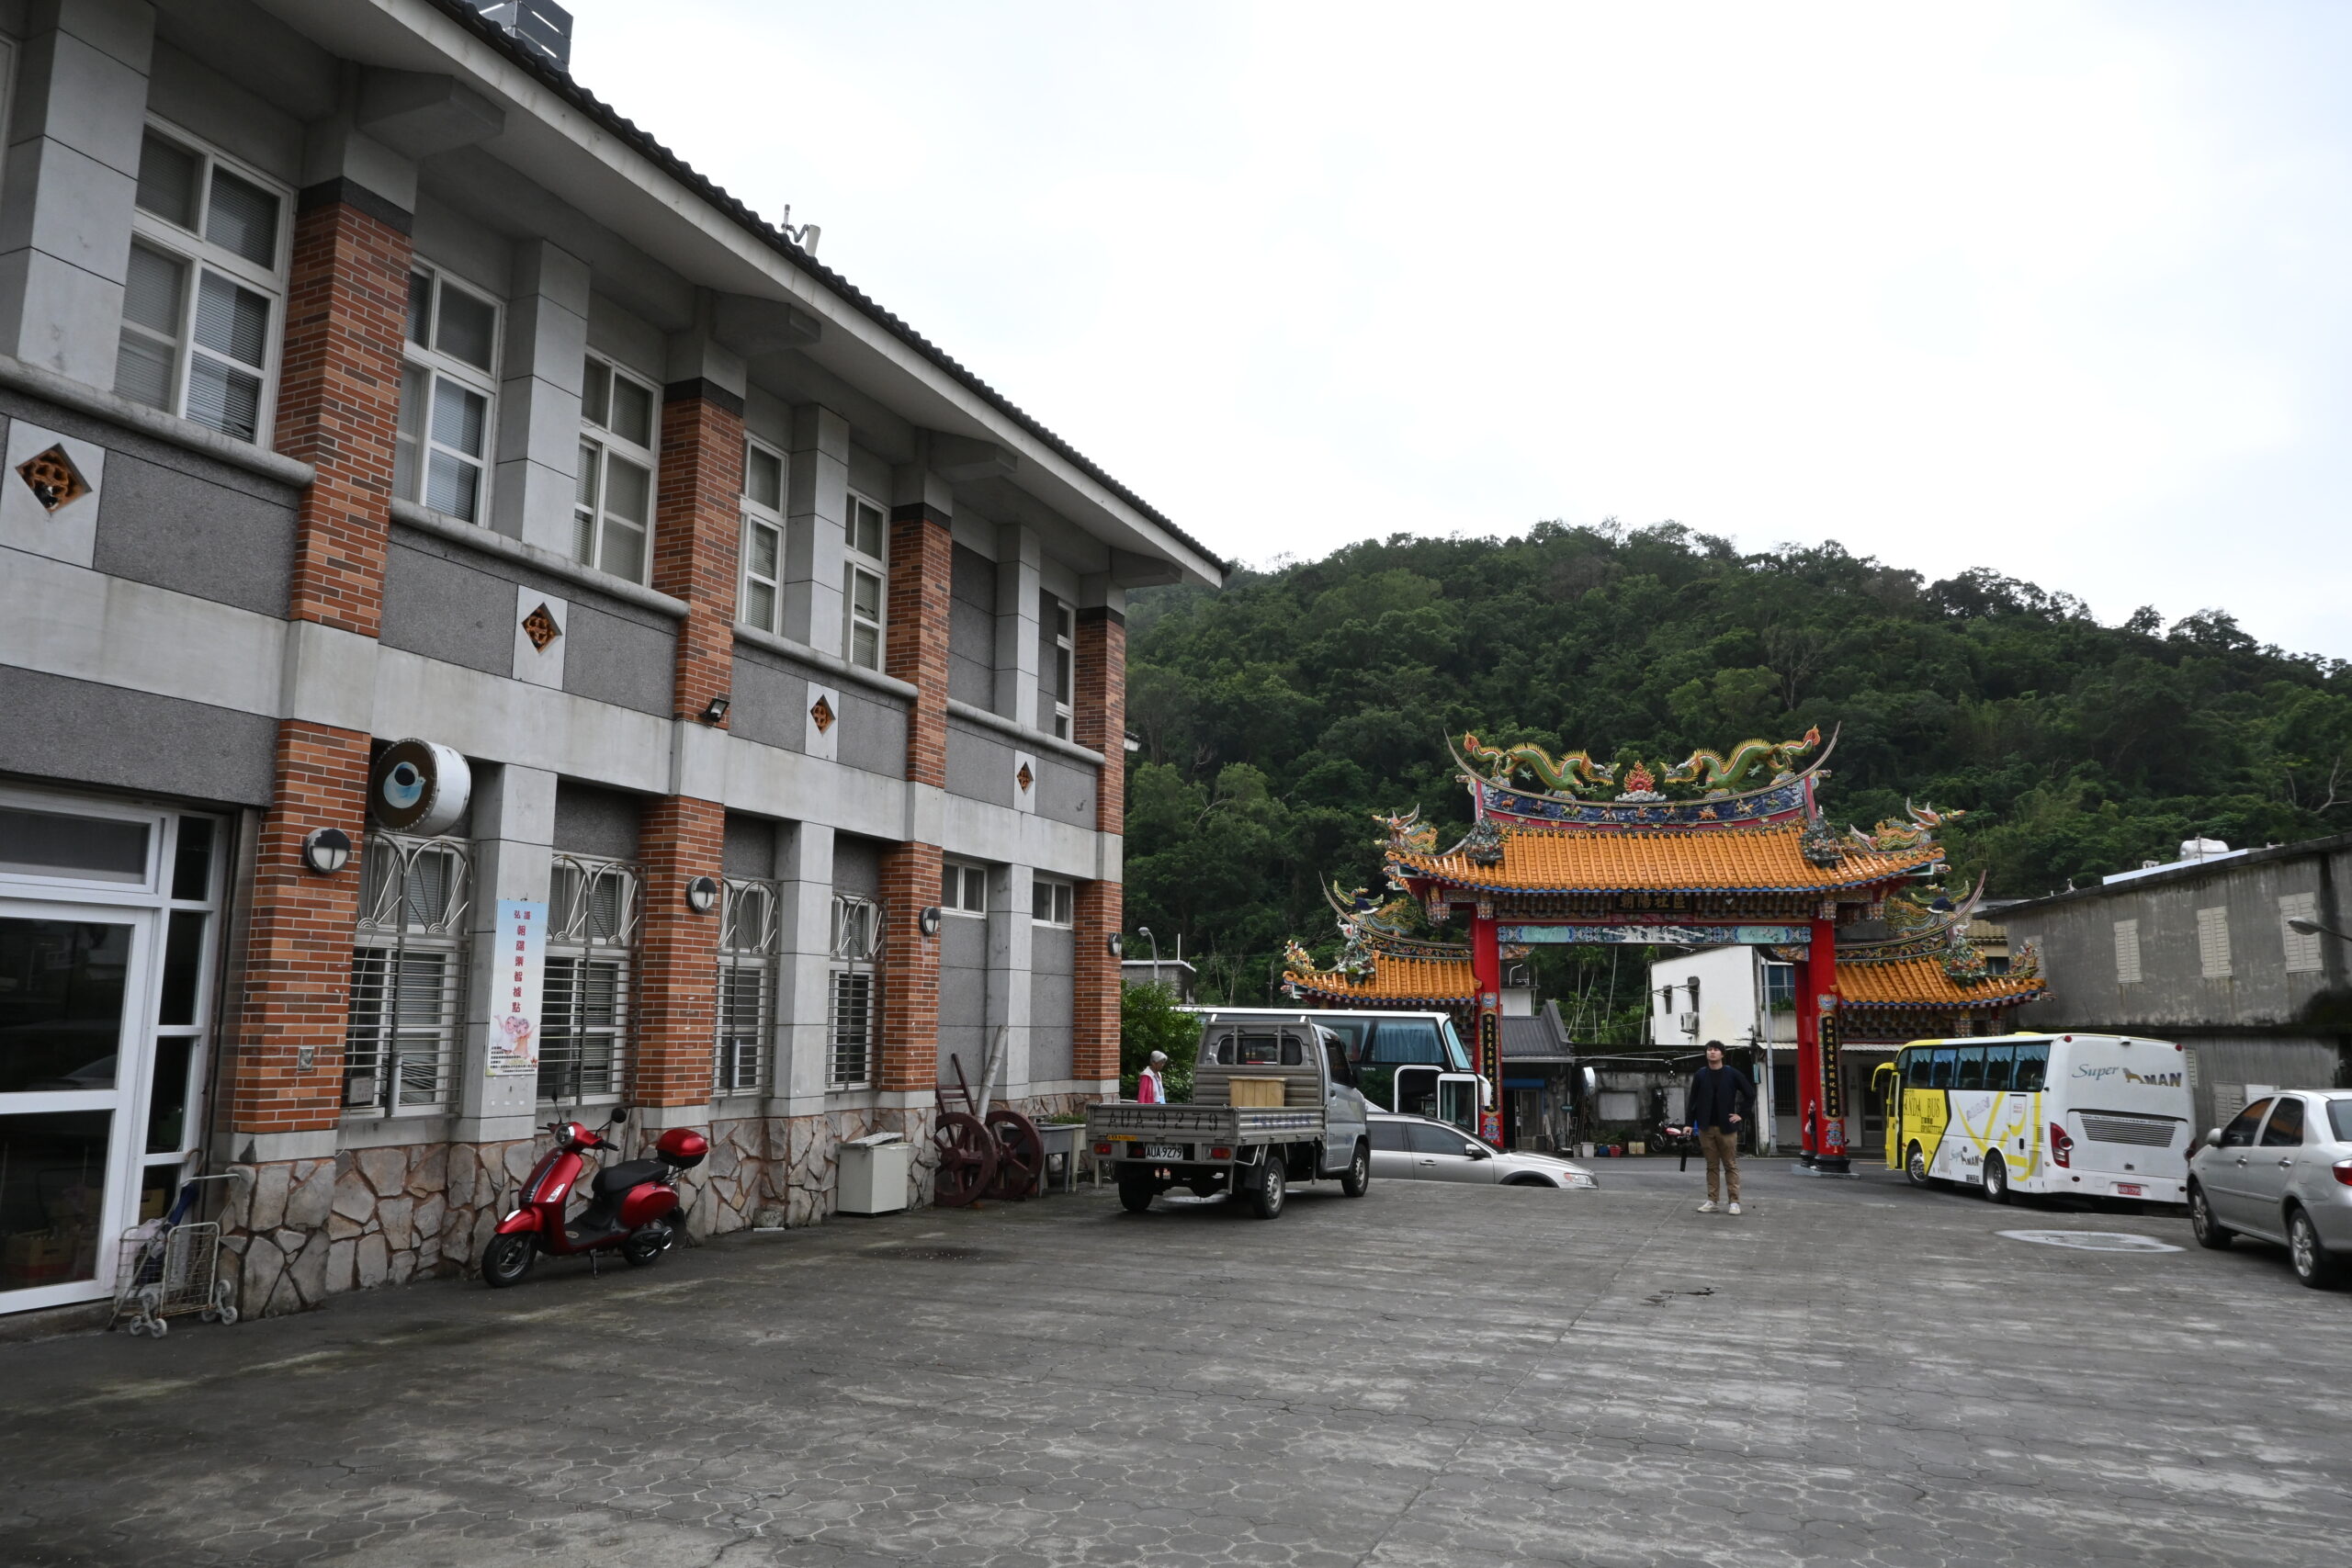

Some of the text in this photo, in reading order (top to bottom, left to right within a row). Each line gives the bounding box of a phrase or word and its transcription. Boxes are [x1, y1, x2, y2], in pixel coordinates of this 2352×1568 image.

[2072, 1064, 2182, 1088] Super MAN
[1928, 1098, 1939, 1118] BUS
